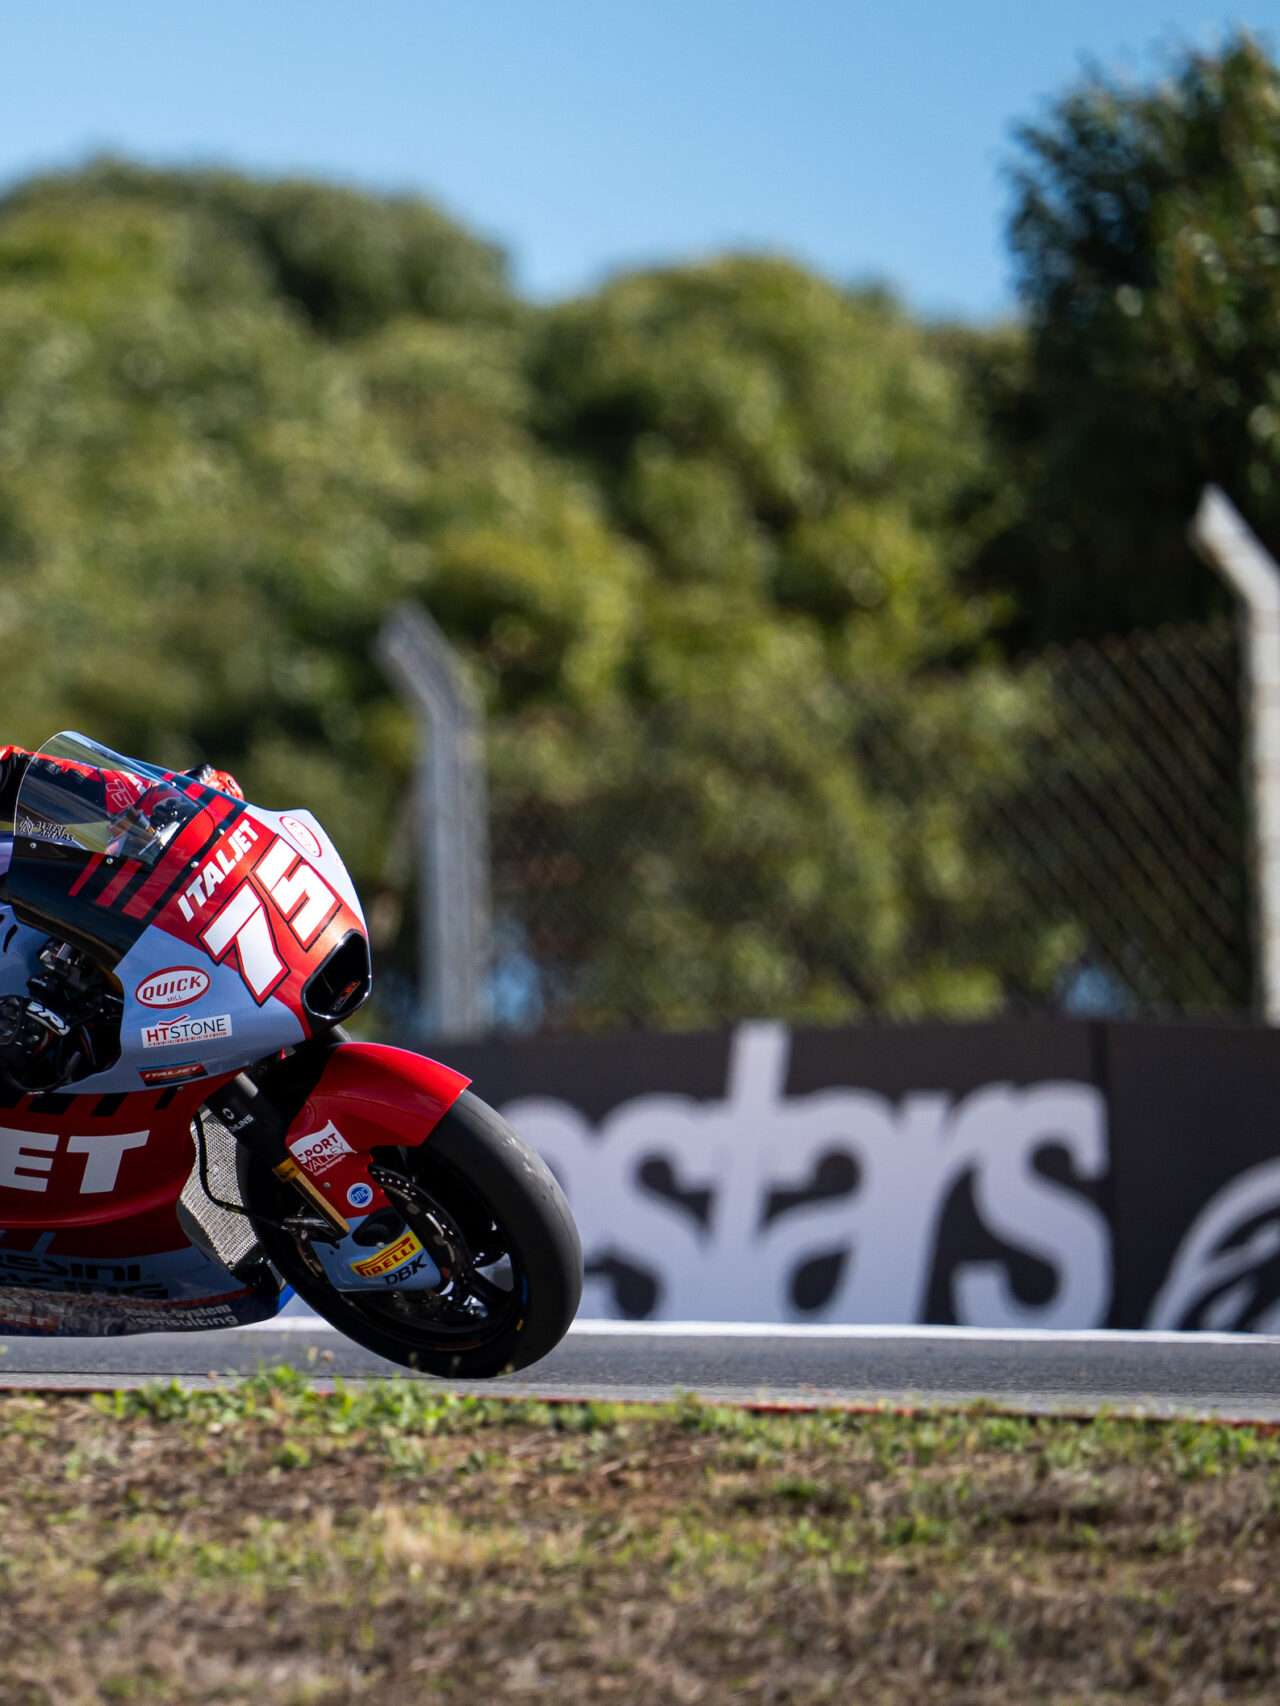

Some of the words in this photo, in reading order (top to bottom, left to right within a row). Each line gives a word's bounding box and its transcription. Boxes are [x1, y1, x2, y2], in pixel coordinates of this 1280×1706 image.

[177, 818, 260, 922] ITALJET
[199, 833, 342, 1005] 75
[142, 976, 202, 1001] QUICK
[146, 1017, 227, 1042] HTSTONE
[355, 1236, 416, 1277] PIRELLI
